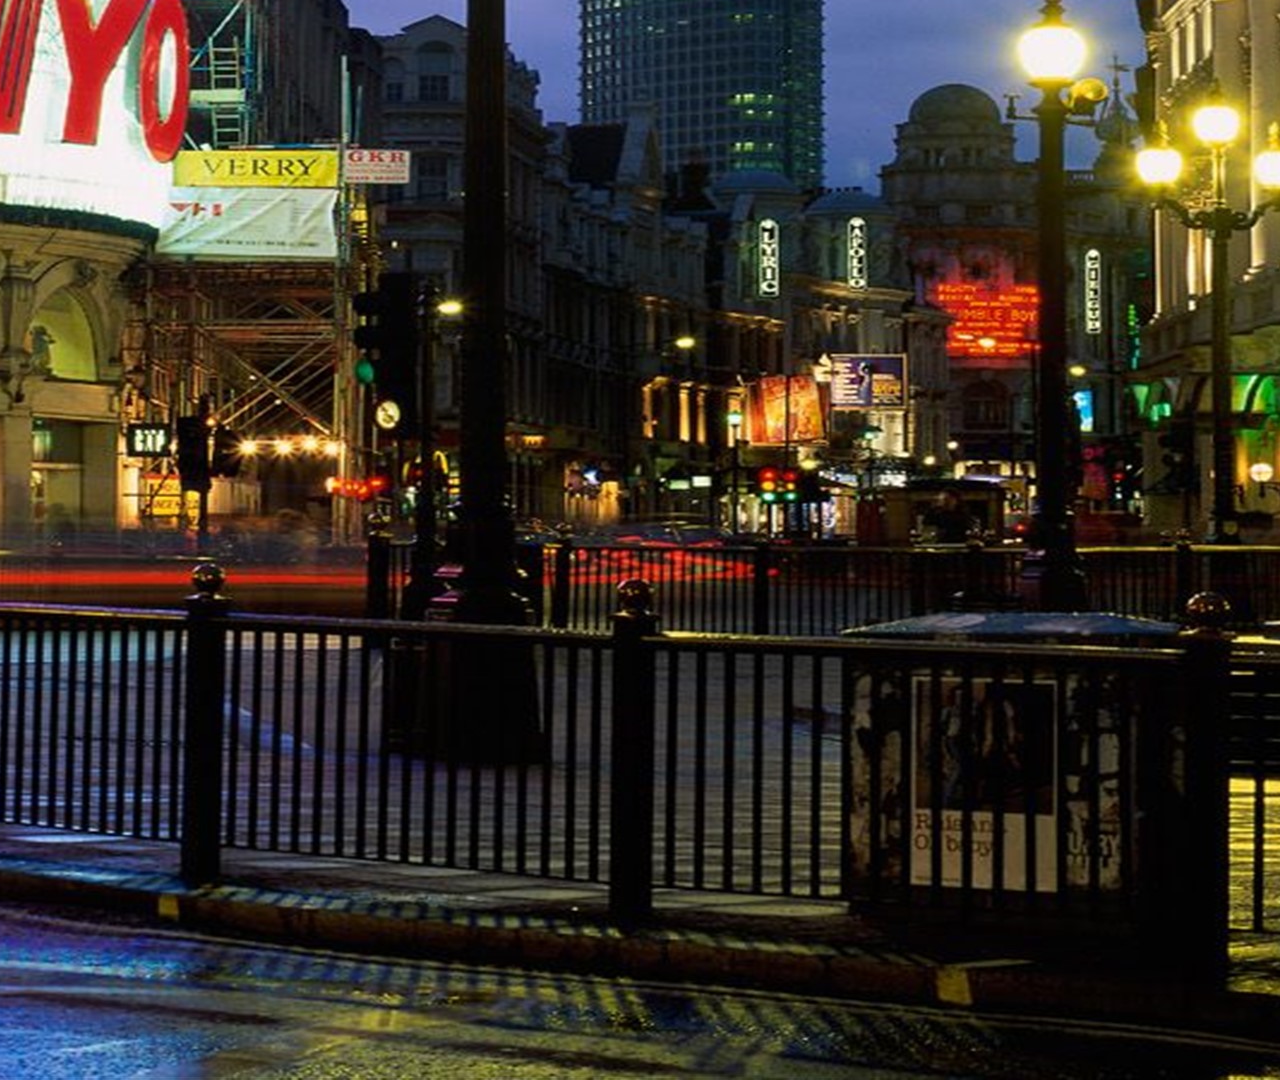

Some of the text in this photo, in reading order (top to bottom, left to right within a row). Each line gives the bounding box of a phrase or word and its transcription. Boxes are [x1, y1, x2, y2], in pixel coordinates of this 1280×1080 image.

[203, 158, 320, 177] VERRY
[760, 228, 778, 293] LYRIC
[848, 224, 866, 289] APOLLO
[134, 428, 166, 452] GAP
